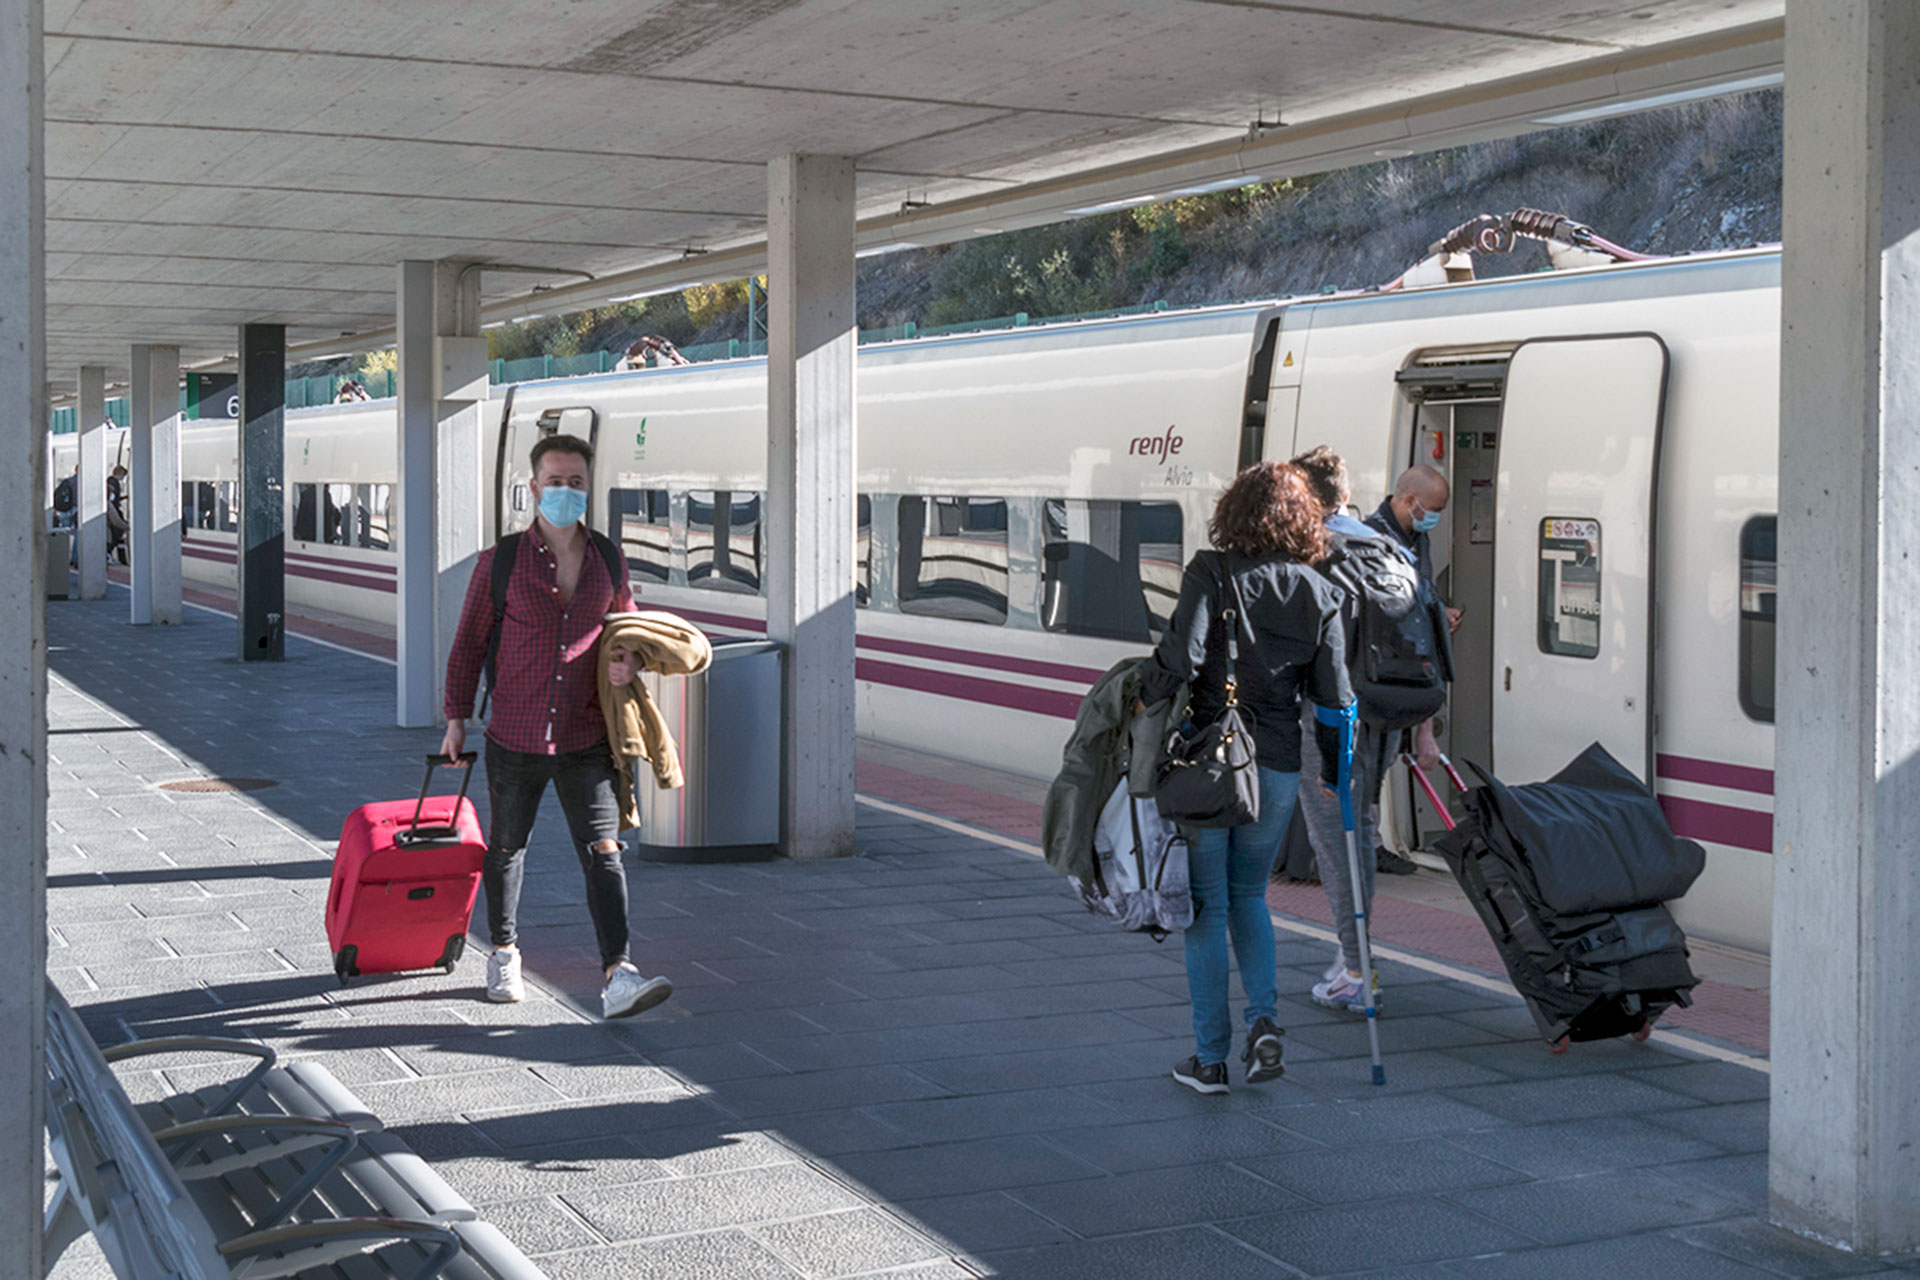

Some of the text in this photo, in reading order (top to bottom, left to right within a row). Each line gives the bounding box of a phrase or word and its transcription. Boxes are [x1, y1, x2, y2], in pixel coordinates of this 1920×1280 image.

[227, 395, 240, 418] 6
[1129, 423, 1184, 466] renfe
[1164, 465, 1193, 486] Alvia
